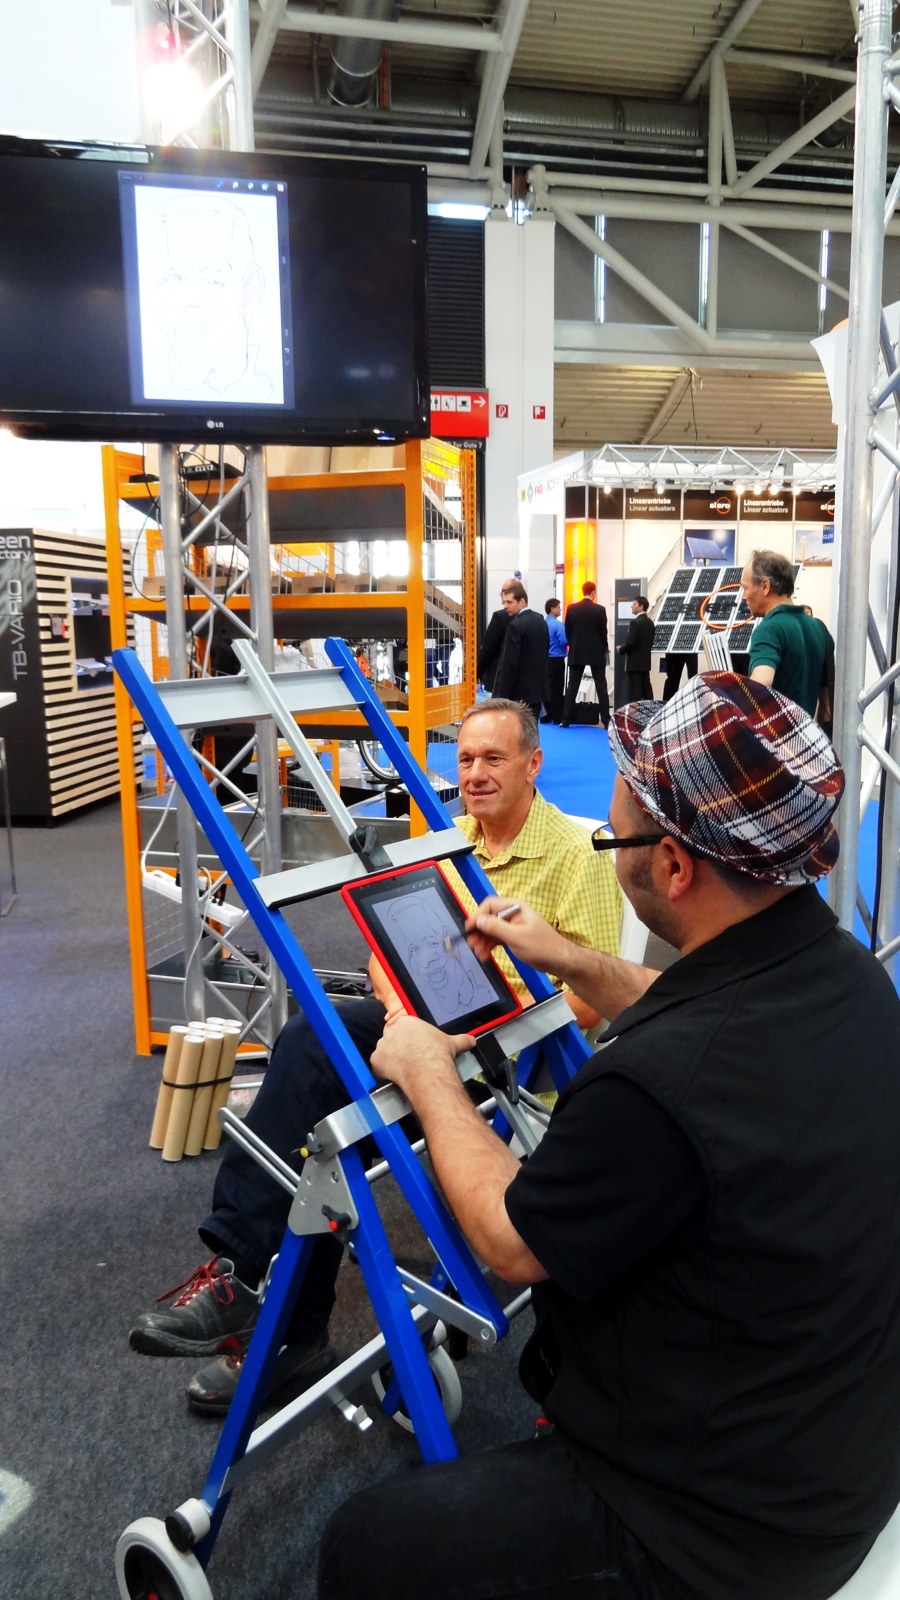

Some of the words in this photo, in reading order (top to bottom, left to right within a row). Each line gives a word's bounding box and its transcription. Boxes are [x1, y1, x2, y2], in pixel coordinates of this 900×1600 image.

[479, 441, 483, 449] 7
[629, 497, 671, 505] Linearantriebe
[709, 501, 730, 509] elero
[743, 499, 784, 507] Linearantriebe
[743, 506, 761, 514] Linear
[762, 506, 789, 514] actuators
